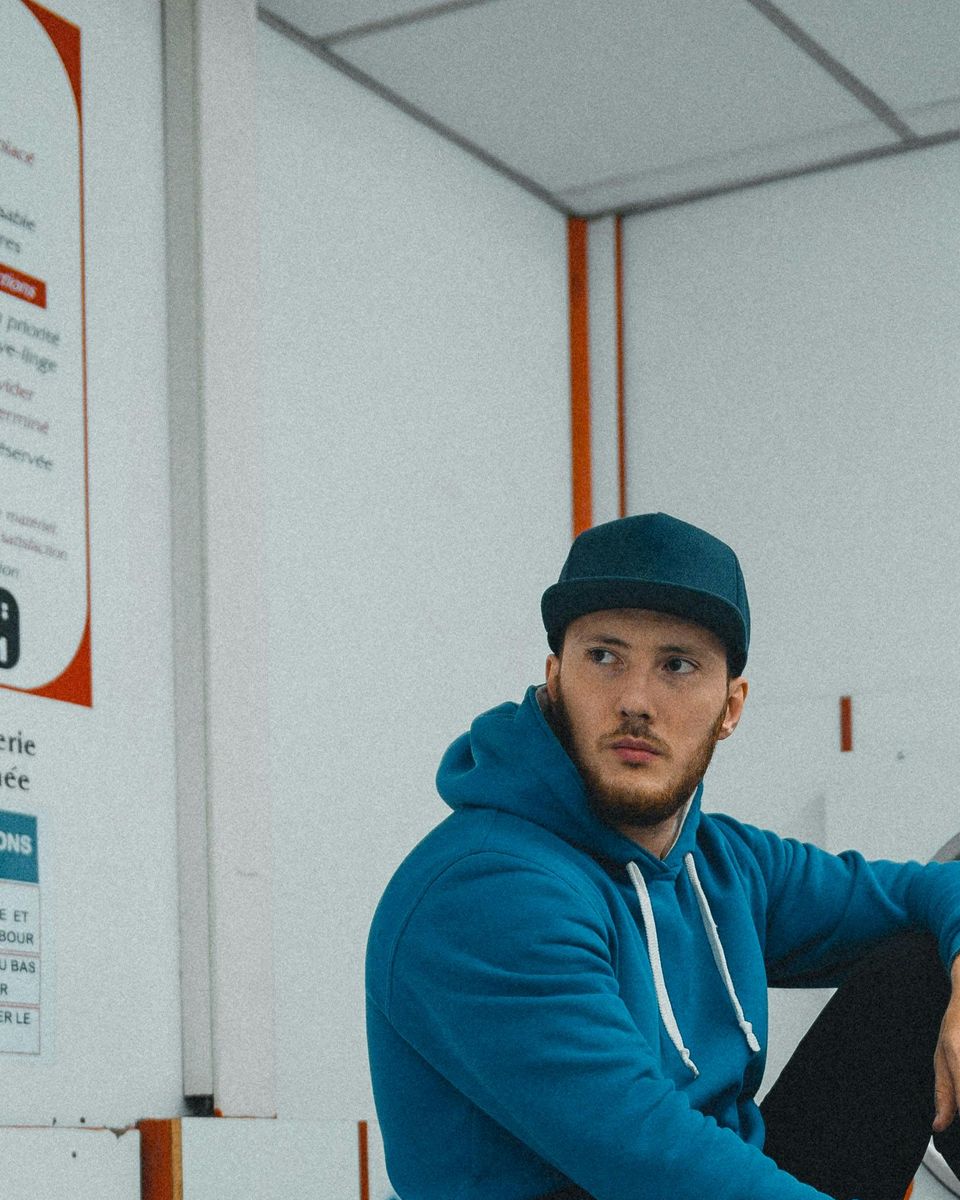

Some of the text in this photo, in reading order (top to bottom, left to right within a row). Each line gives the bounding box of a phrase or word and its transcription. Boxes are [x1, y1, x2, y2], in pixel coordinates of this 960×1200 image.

[14, 910, 29, 923] ET
[11, 960, 36, 973] BAS
[16, 1012, 31, 1025] LE
